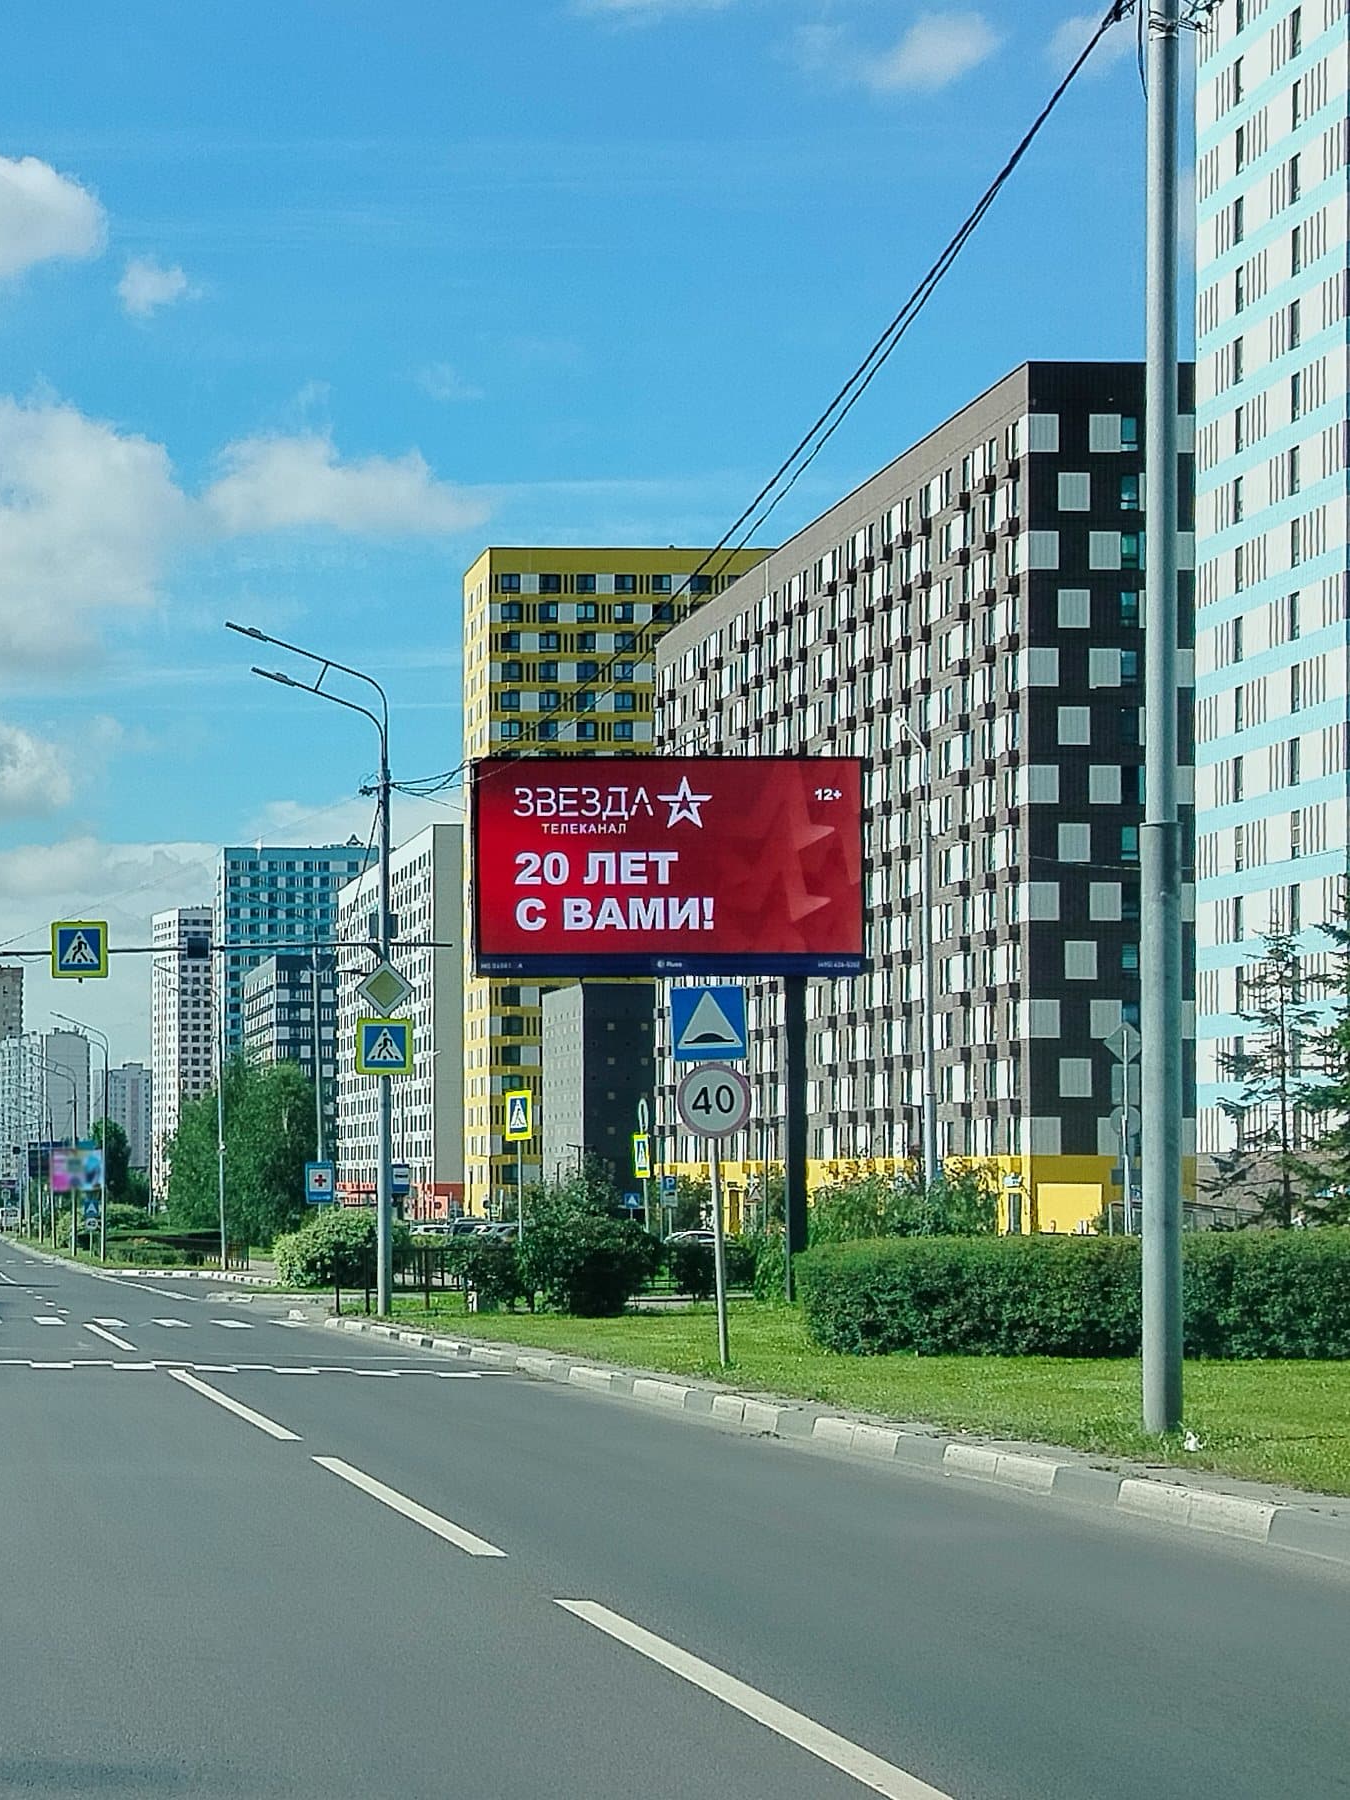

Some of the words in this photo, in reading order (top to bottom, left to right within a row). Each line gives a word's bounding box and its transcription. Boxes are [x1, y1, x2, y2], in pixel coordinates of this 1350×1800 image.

[513, 786, 654, 821] ЗВЕЗДА
[814, 788, 843, 801] 12+
[541, 822, 627, 835] ТЕЛЕКАНАЛ
[514, 851, 570, 885] 20
[583, 851, 679, 885] ЛЕТ
[515, 898, 547, 931] С
[563, 898, 714, 931] ВАМИ!
[691, 1084, 735, 1115] 40
